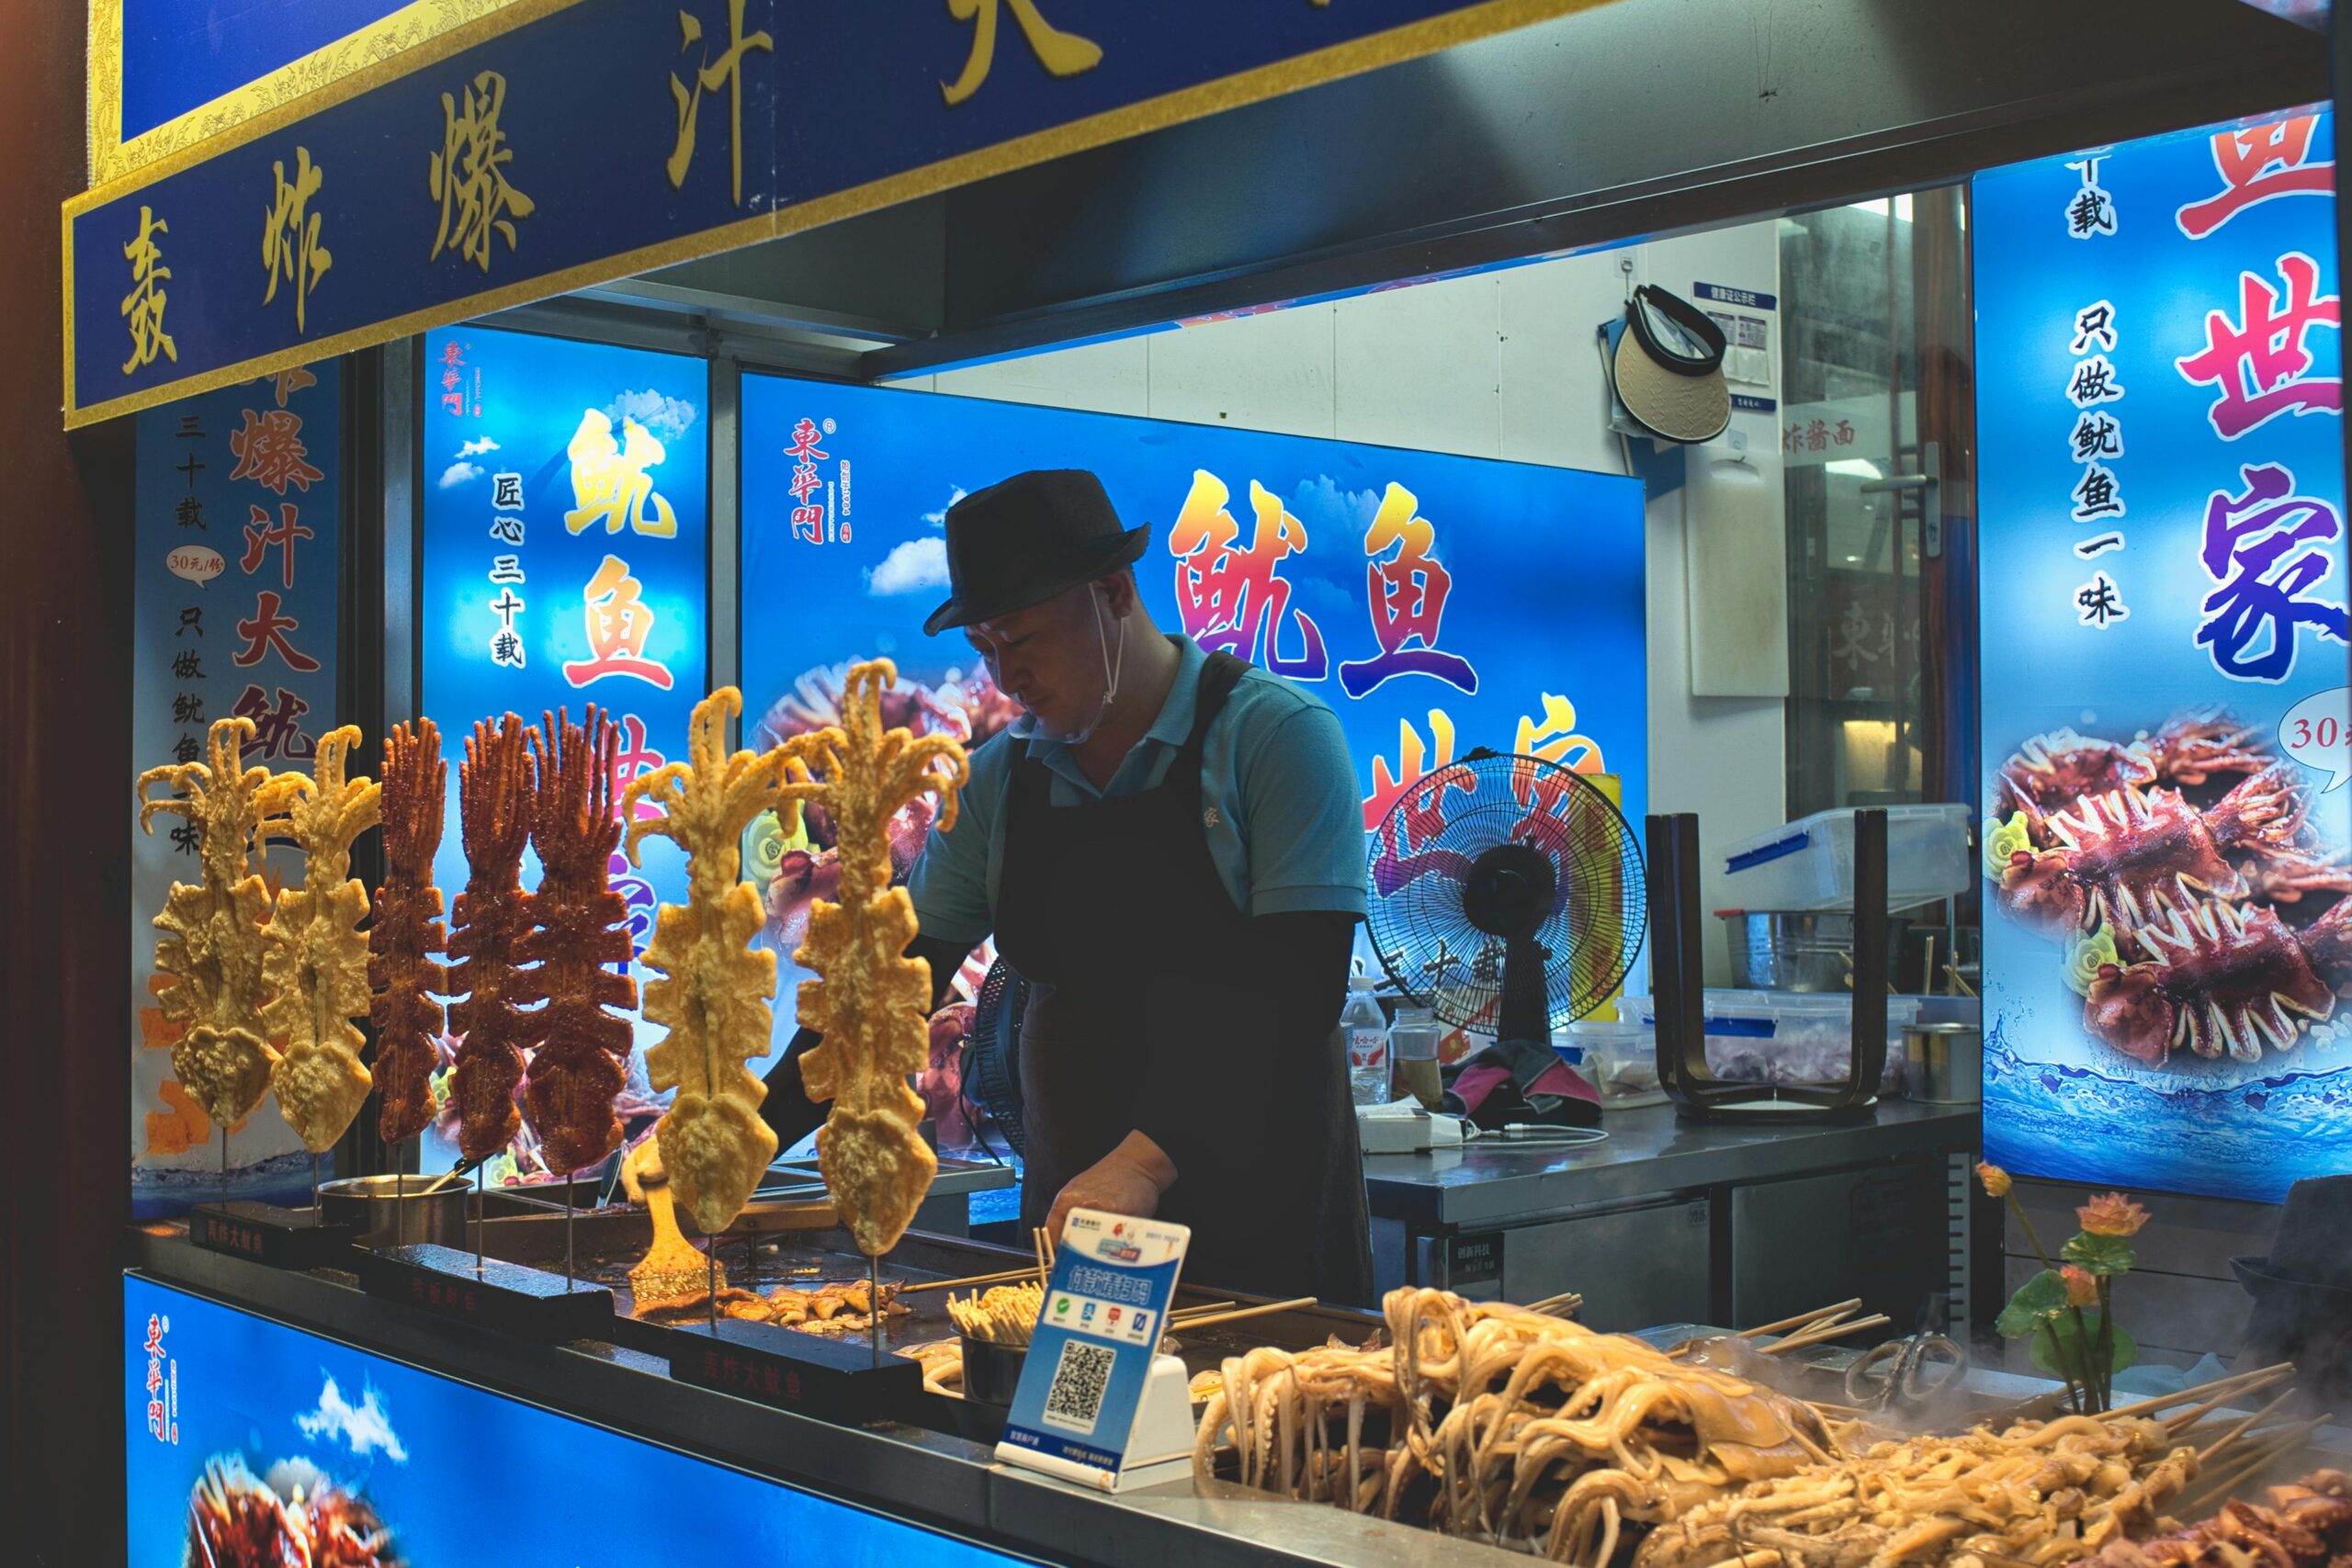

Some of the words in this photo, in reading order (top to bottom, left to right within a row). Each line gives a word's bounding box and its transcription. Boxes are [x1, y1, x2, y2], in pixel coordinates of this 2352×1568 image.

[784, 418, 829, 544] 東華門
[2075, 306, 2123, 624] 只做鱿鱼一味
[223, 365, 325, 845] 爆汁大鱿
[492, 475, 524, 666] 匠心三十载
[1170, 469, 1477, 699] 鱿鱼
[145, 1314, 165, 1441] 東華門
